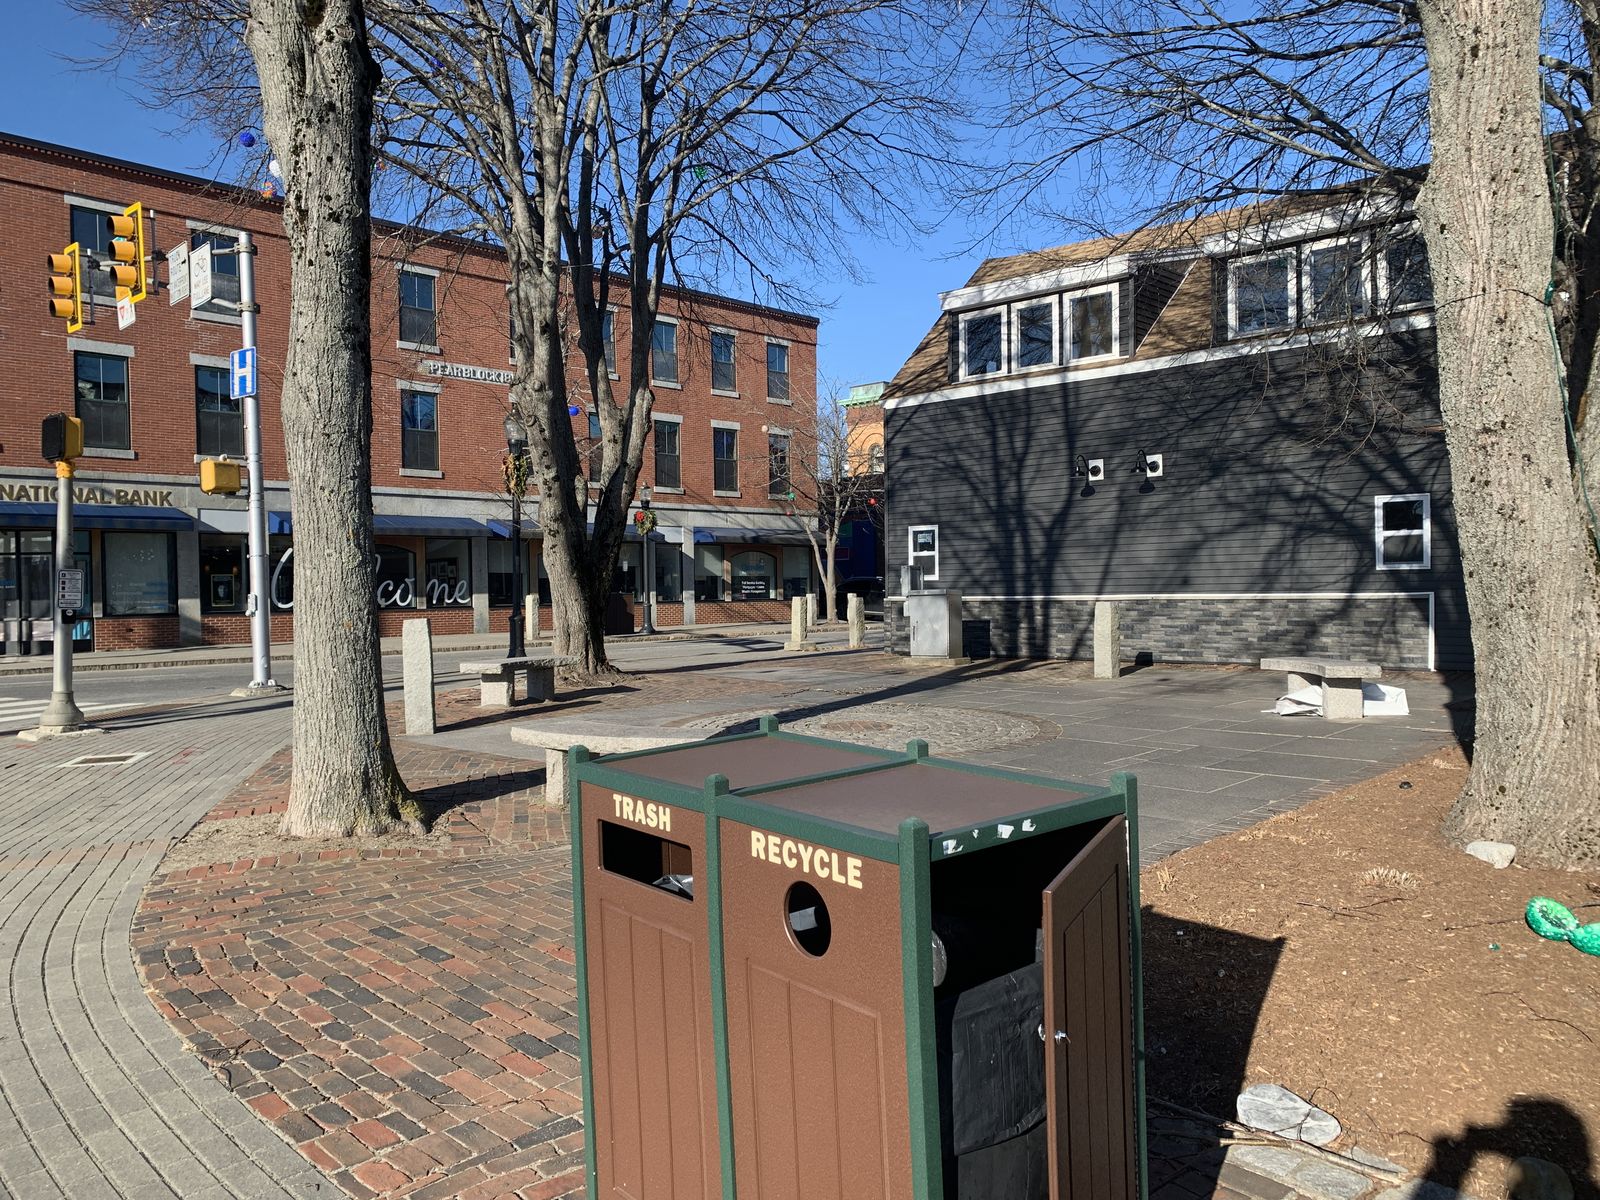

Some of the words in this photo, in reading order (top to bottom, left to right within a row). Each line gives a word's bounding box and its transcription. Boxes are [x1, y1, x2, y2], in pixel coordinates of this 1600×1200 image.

[233, 350, 252, 397] H
[115, 488, 173, 507] BANK
[612, 793, 671, 832] TRASH
[750, 830, 863, 890] RECYCLE
